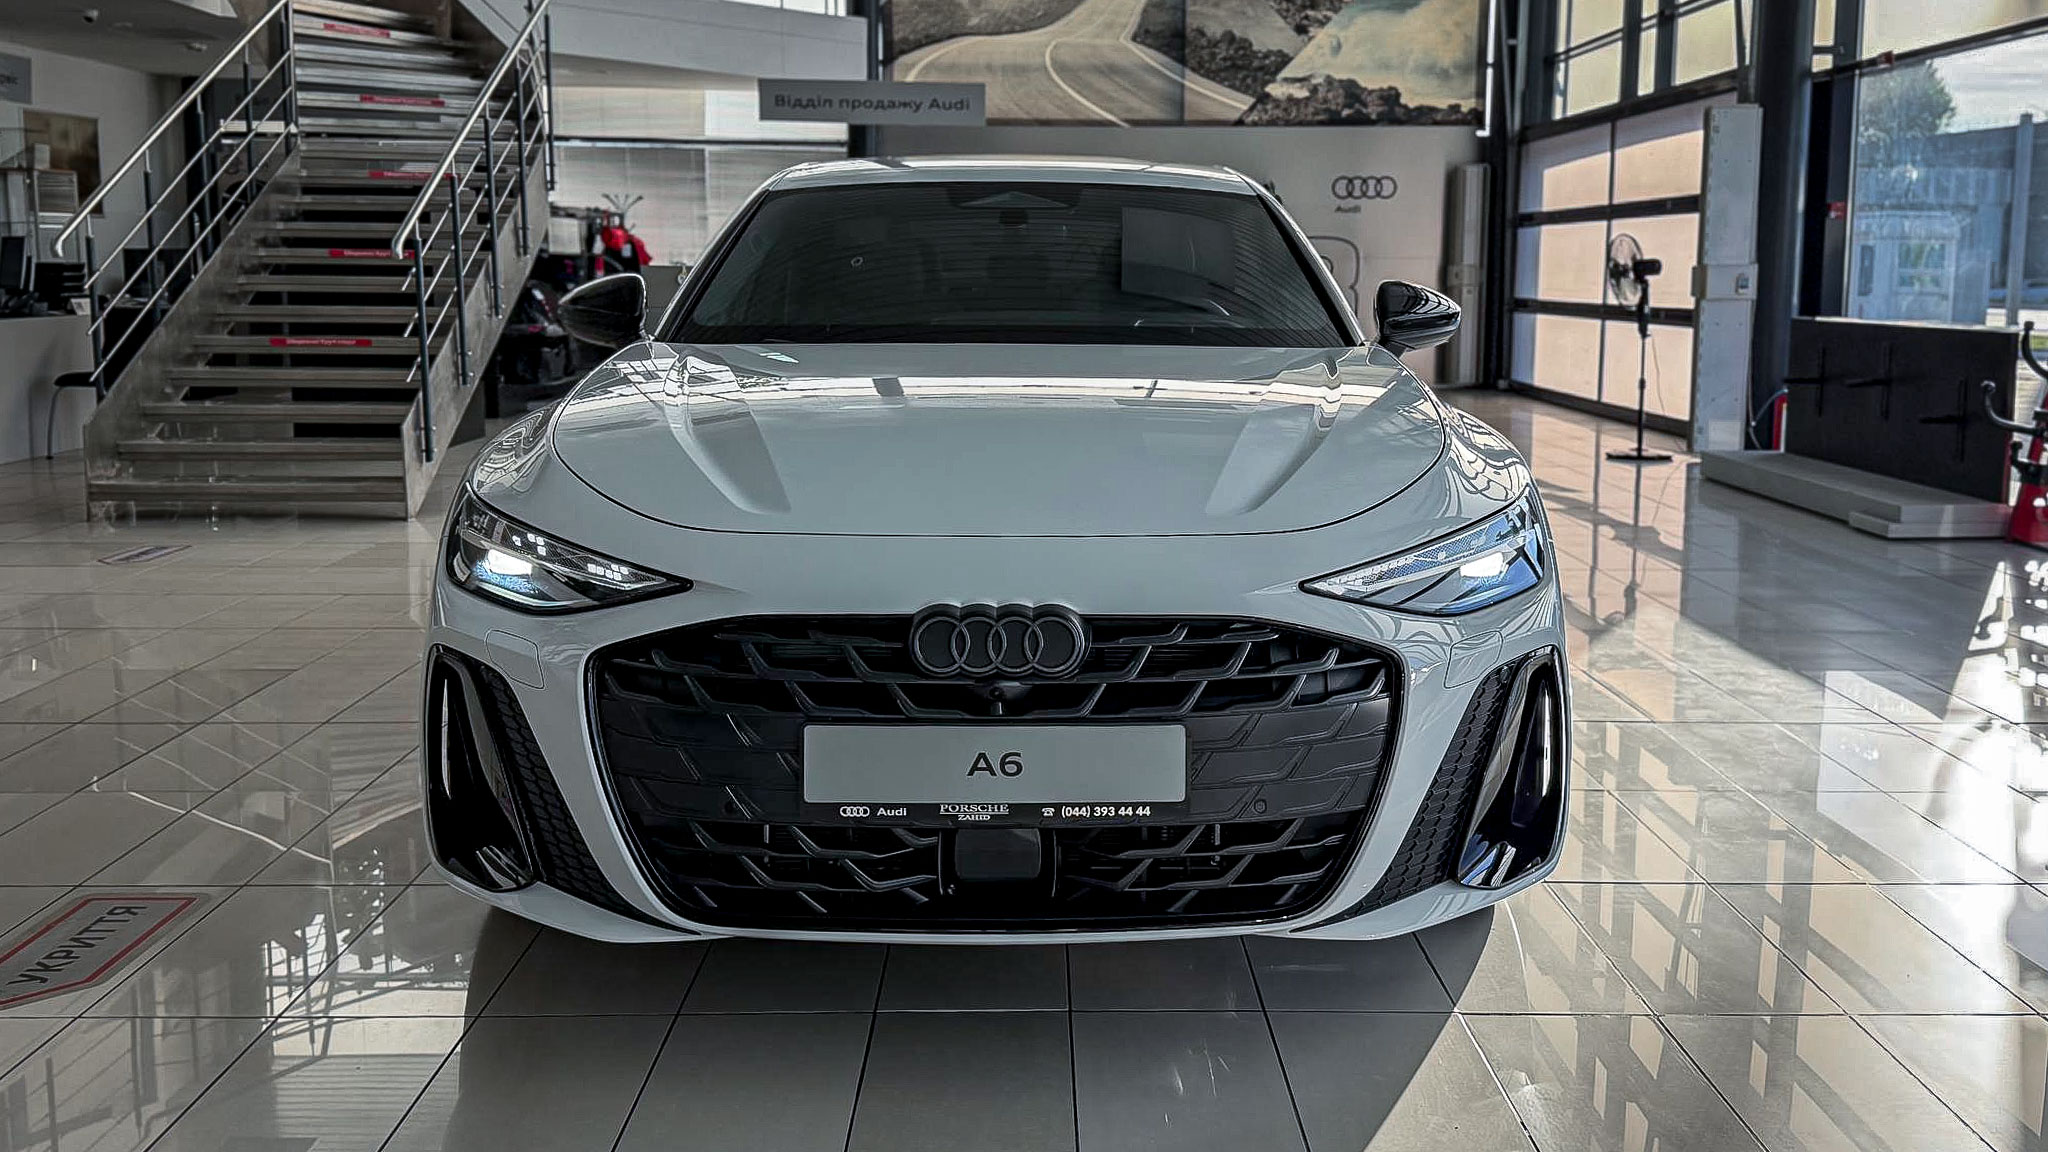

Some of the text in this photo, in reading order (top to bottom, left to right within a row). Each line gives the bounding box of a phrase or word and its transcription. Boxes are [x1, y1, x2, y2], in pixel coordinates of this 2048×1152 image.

[774, 94, 971, 113] Відділ продажу Audi
[966, 751, 1024, 777] A6
[876, 807, 907, 817] Audi
[940, 804, 1009, 813] PORSCHE
[1061, 806, 1151, 818] (044) 393 44 44
[5, 906, 148, 985] УКРИТТЯ
